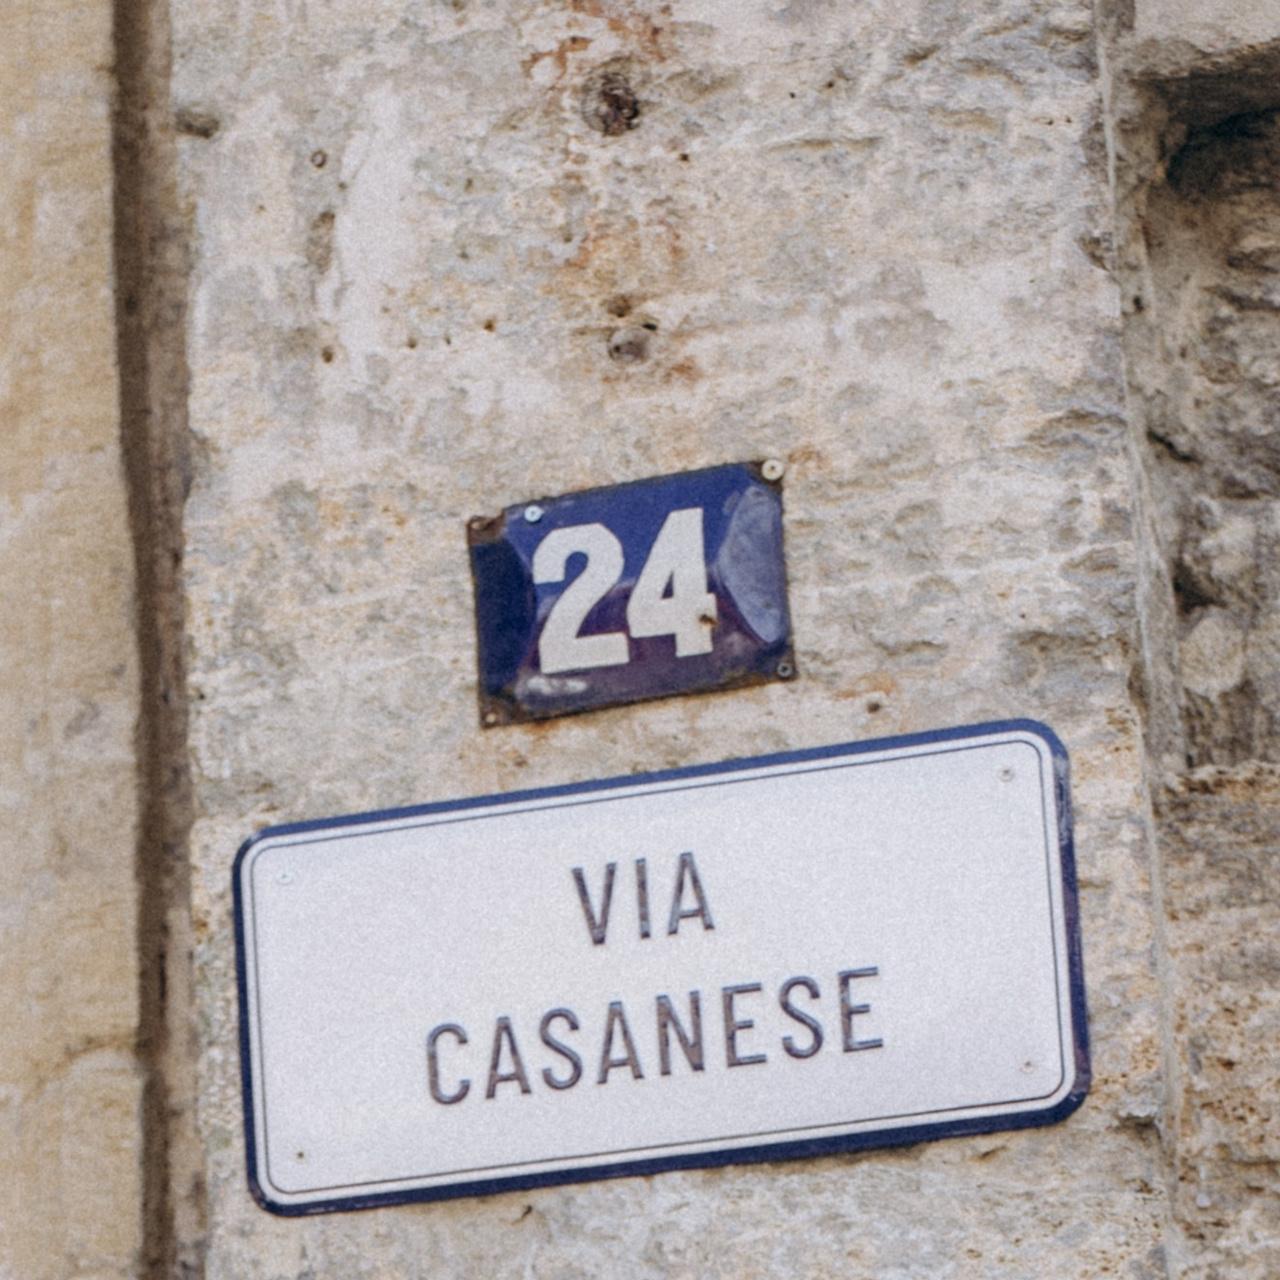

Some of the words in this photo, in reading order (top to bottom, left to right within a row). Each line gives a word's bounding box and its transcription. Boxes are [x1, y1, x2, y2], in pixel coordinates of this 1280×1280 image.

[532, 508, 718, 674] 24
[572, 852, 715, 945] VIA
[427, 966, 883, 1104] CASANESE
